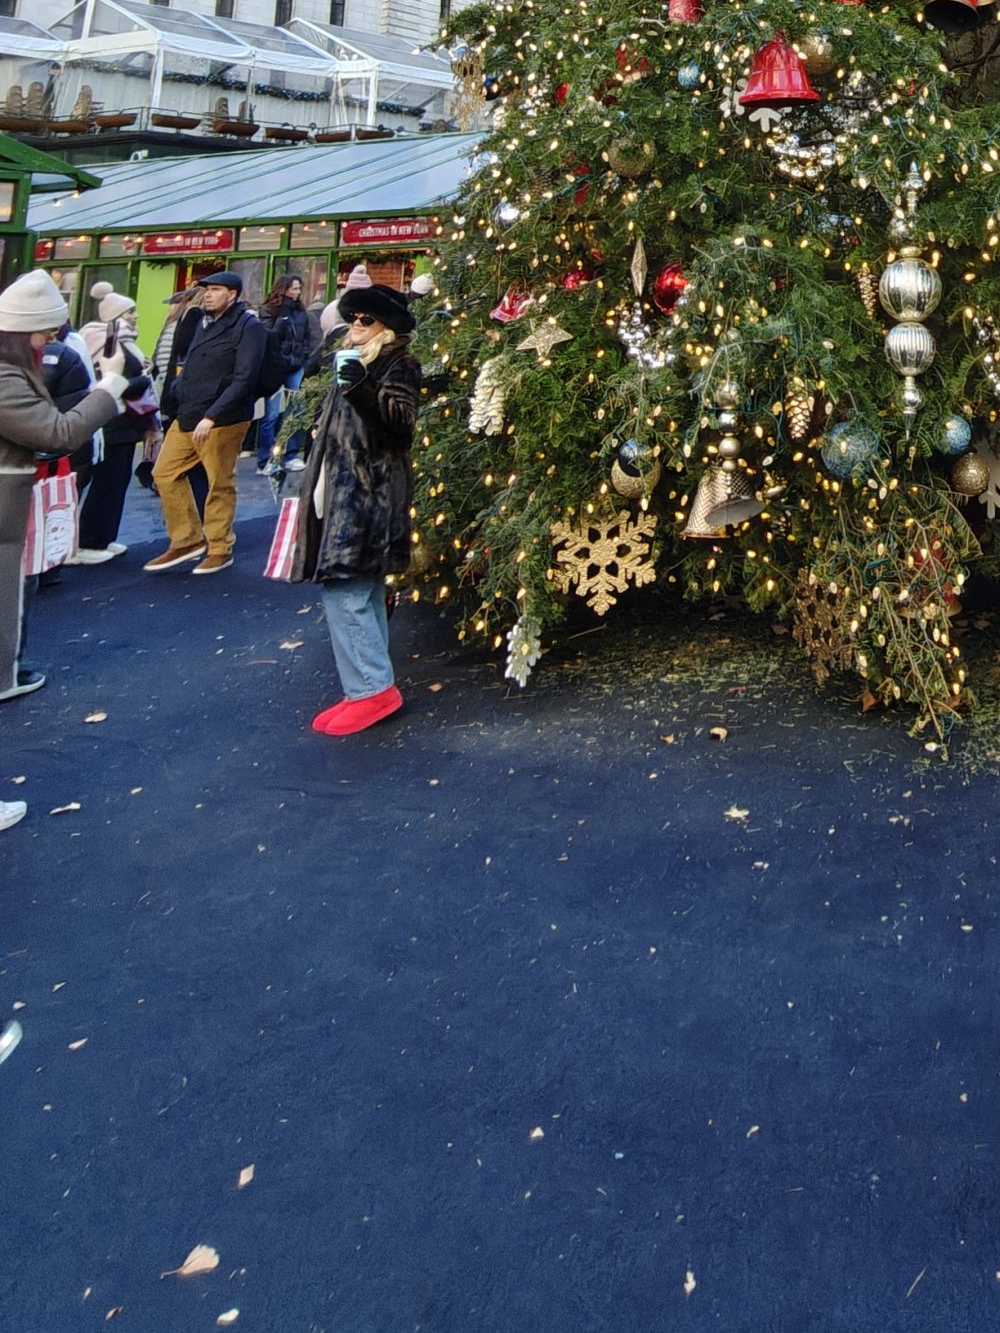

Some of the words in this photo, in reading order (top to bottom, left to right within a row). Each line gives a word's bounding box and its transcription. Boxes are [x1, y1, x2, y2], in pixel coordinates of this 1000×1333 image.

[359, 227, 390, 237] CHRISTMAS
[398, 226, 412, 235] NEW
[414, 226, 429, 235] YORK
